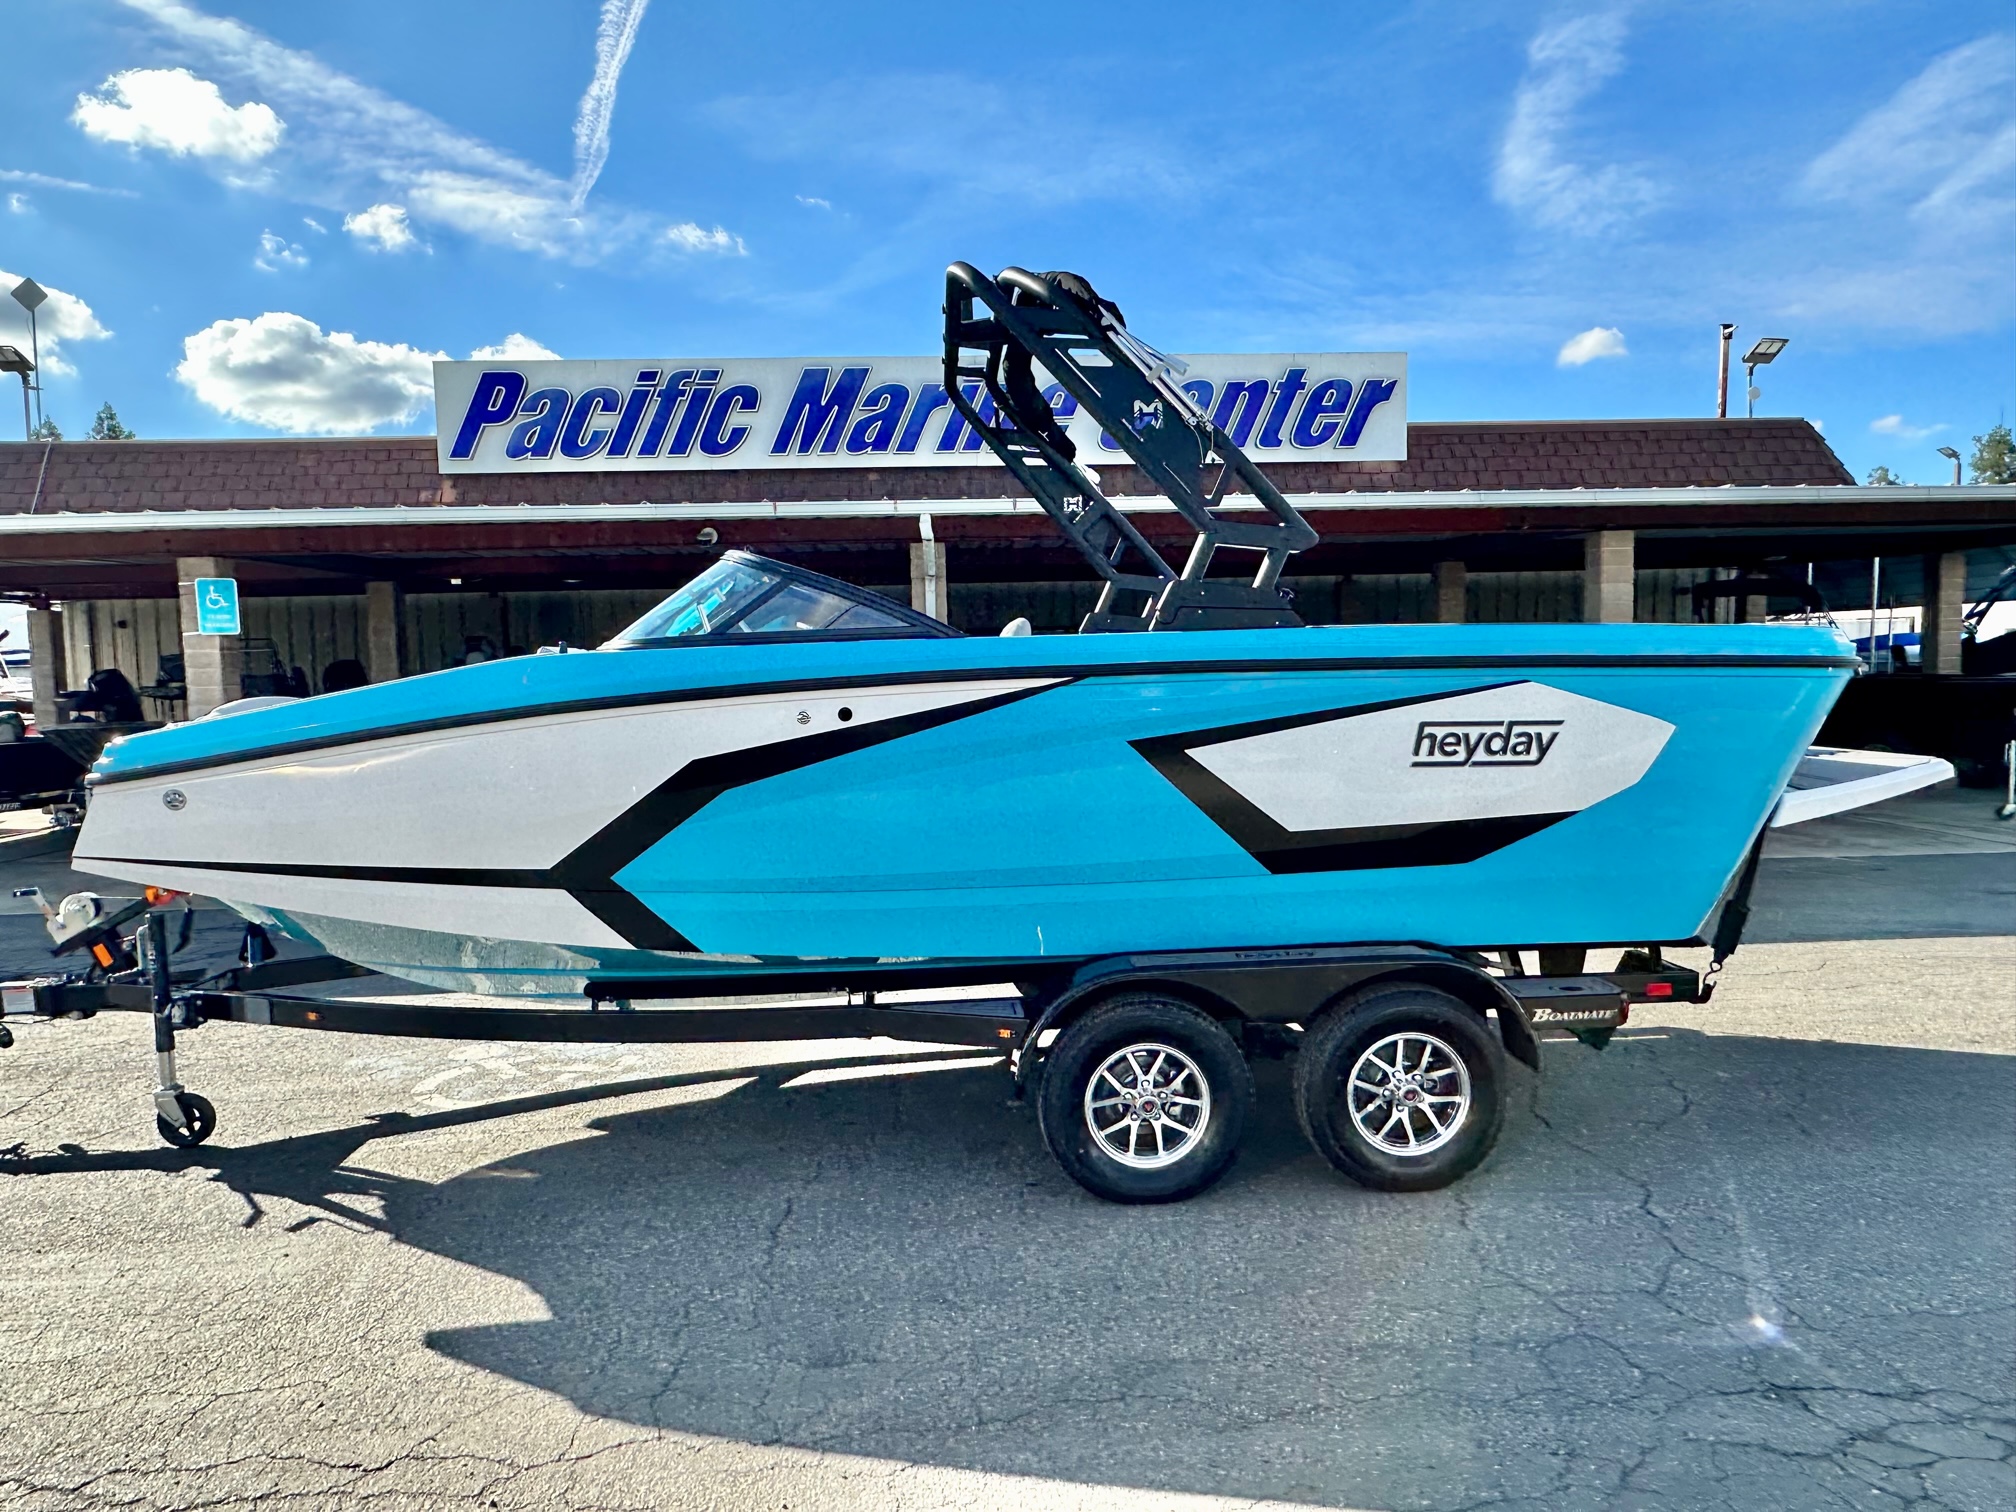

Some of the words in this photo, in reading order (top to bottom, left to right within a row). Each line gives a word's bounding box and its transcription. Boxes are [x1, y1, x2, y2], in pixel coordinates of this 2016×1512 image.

[448, 368, 761, 460] Pacific
[1098, 366, 1399, 455] nter
[1410, 720, 1565, 767] heyday
